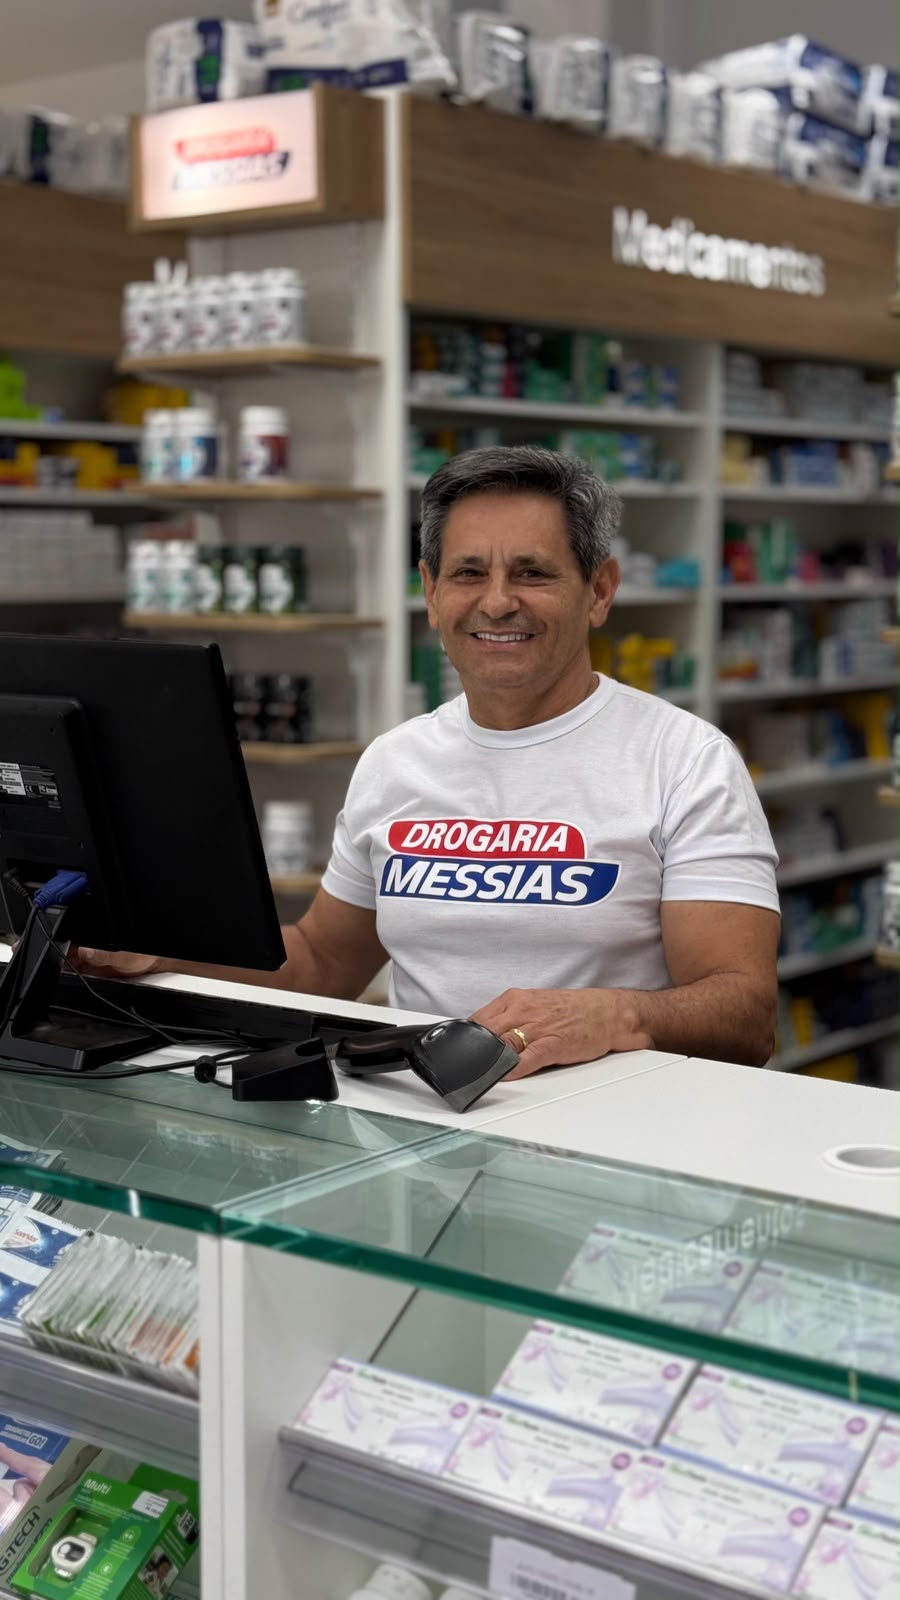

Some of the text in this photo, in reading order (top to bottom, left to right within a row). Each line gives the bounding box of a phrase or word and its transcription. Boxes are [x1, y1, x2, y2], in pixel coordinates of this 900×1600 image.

[612, 205, 826, 297] Medicamentos
[401, 822, 568, 852] DROGARIA
[384, 858, 595, 902] MESSIAS
[84, 1478, 112, 1494] Multi
